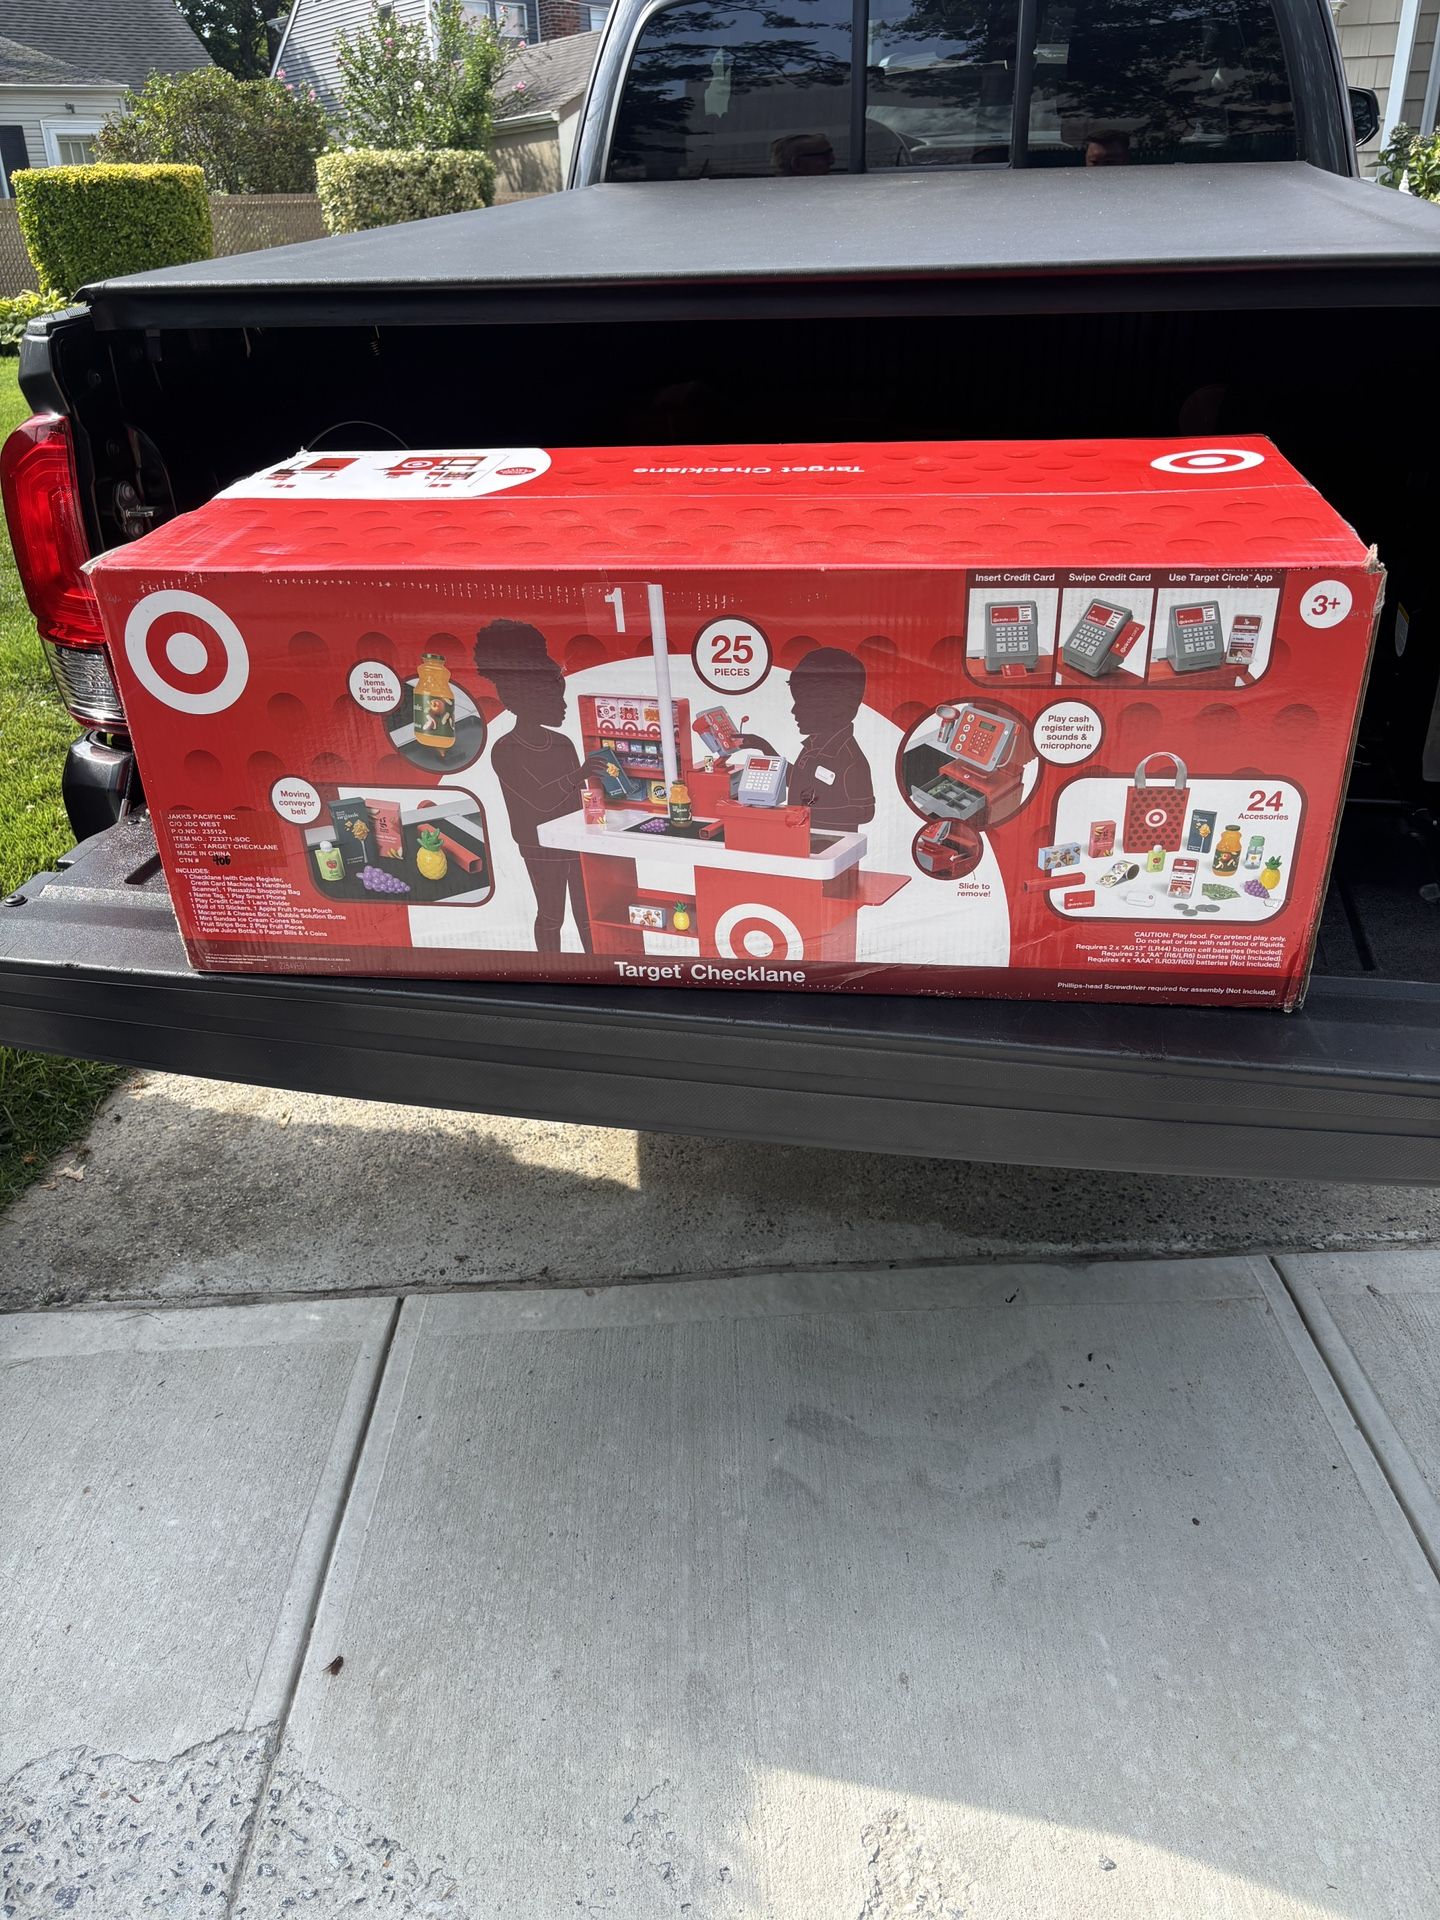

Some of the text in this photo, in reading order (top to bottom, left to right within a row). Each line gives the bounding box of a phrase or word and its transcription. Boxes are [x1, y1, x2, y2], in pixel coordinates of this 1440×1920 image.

[1069, 574, 1096, 582] Swipe
[1189, 574, 1219, 583] Target
[1254, 574, 1272, 583] App
[1311, 595, 1340, 615] 3+
[605, 588, 625, 632] 1
[711, 636, 753, 664] 25
[714, 668, 750, 676] PIECES
[1048, 715, 1066, 724] Play
[1041, 724, 1074, 733] register
[1041, 742, 1092, 750] microphone
[280, 790, 310, 799] Moving
[279, 799, 315, 808] conveyor
[1247, 790, 1283, 811] 24
[614, 962, 806, 982] Target Checklane
